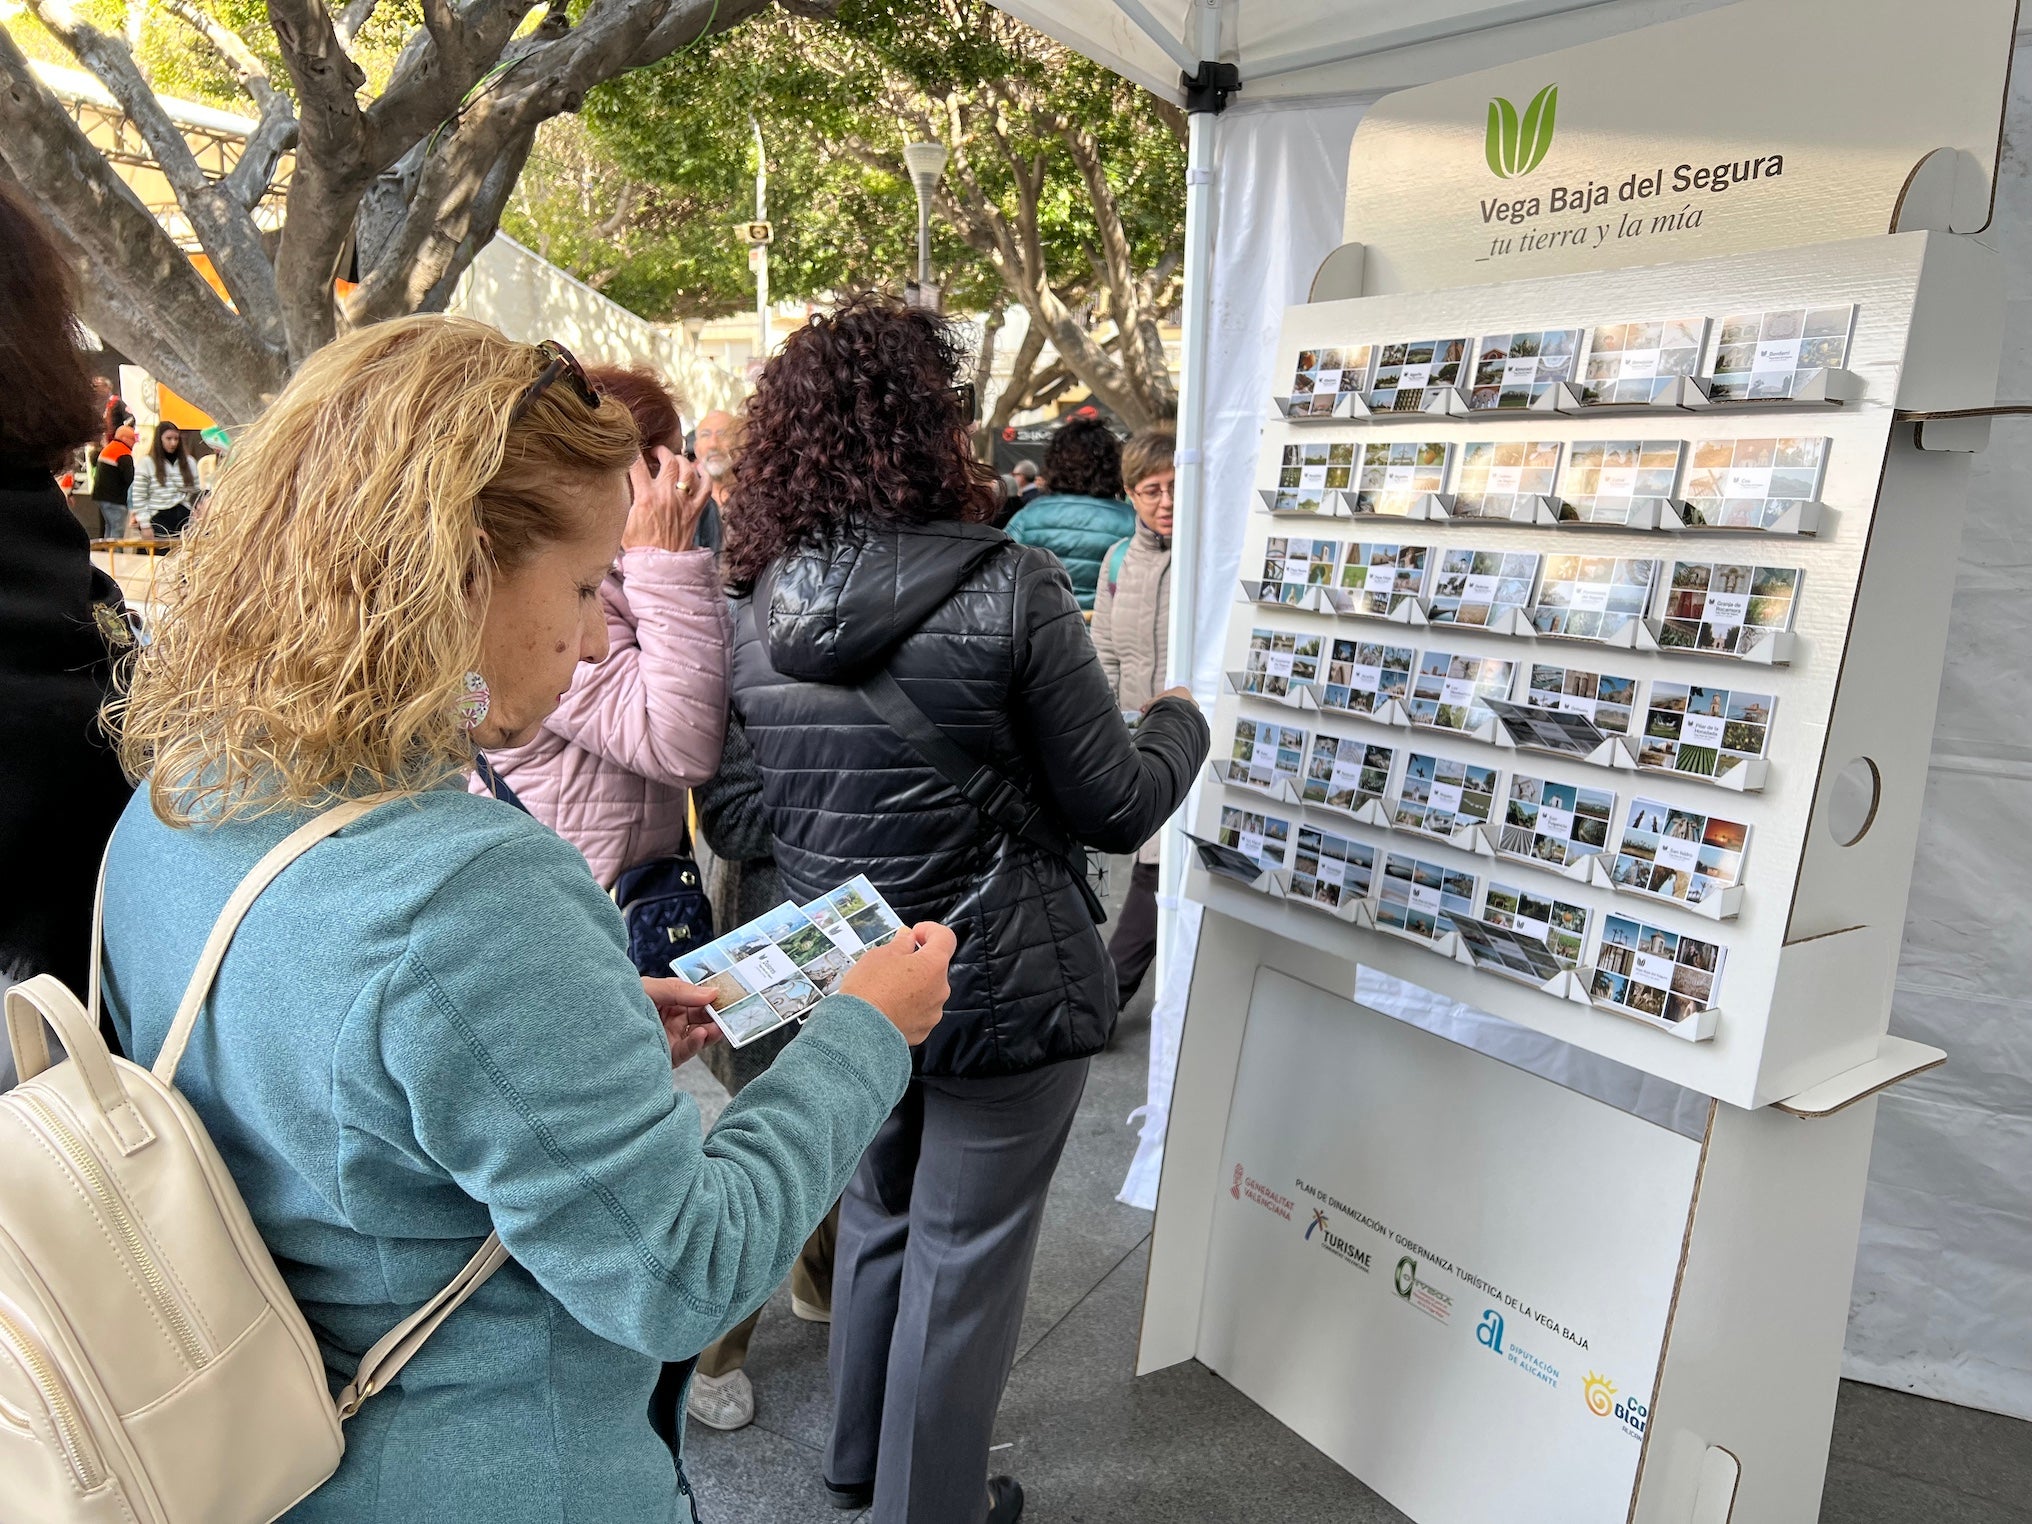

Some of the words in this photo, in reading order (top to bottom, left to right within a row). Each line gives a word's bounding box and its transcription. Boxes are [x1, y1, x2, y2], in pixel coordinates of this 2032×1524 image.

[1480, 195, 1540, 225] Vega
[1549, 181, 1609, 215] Baja
[1618, 169, 1663, 203] del
[1672, 154, 1784, 193] Segura
[1519, 226, 1587, 254] tierra
[1594, 222, 1611, 249] y
[1617, 213, 1643, 240] la
[1650, 203, 1704, 235] mía
[1244, 1187, 1292, 1222] VALENCIANA
[1245, 1176, 1295, 1211] GENERALITAT
[1295, 1178, 1316, 1197] PLAN
[1316, 1190, 1328, 1204] DE
[1328, 1196, 1387, 1236] DINAMIZACIÓN
[1388, 1229, 1395, 1239] Y
[1395, 1233, 1454, 1274] GOBERNANZA
[1455, 1266, 1503, 1302] TURÍSTICA
[1504, 1294, 1519, 1310] DE
[1519, 1302, 1532, 1318] LA
[1534, 1310, 1560, 1334] VEGA
[1562, 1327, 1589, 1351] BAJA
[1324, 1230, 1372, 1268] TURISME
[1507, 1353, 1518, 1364] DE
[1519, 1360, 1558, 1389] ALICANTE
[1509, 1343, 1560, 1378] DIPUTACIÓN
